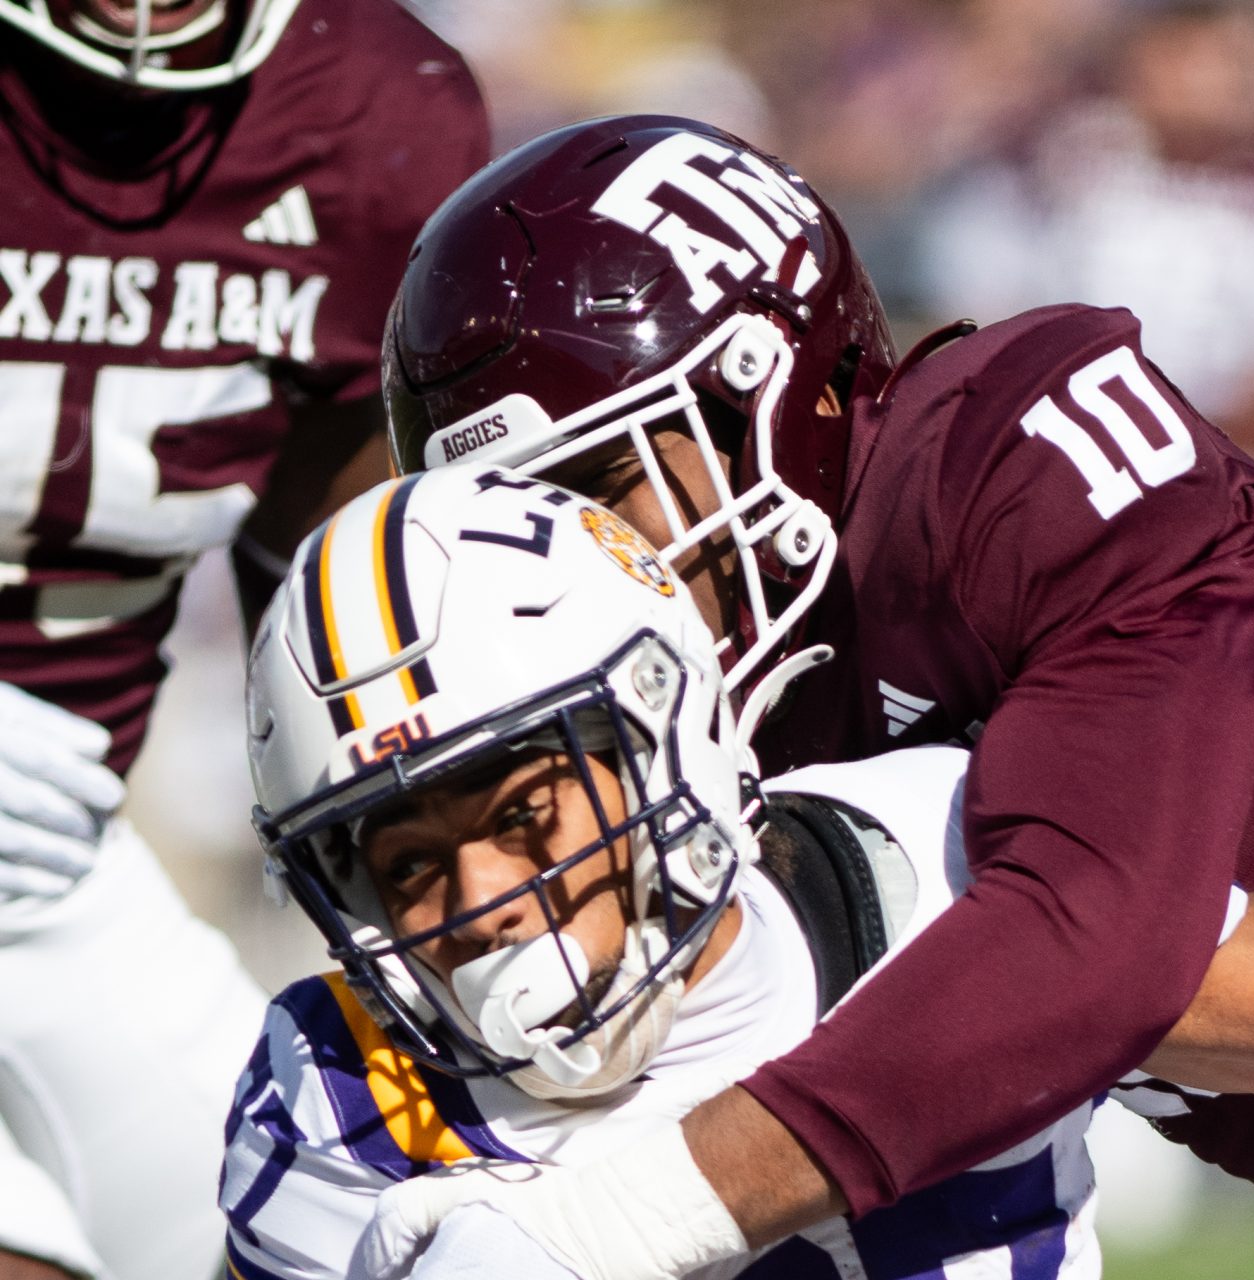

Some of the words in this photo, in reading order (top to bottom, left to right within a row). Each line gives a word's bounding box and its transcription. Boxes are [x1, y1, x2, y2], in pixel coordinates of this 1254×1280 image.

[161, 261, 329, 362] A&M
[440, 413, 509, 463] AGGIES
[1020, 345, 1196, 520] 10
